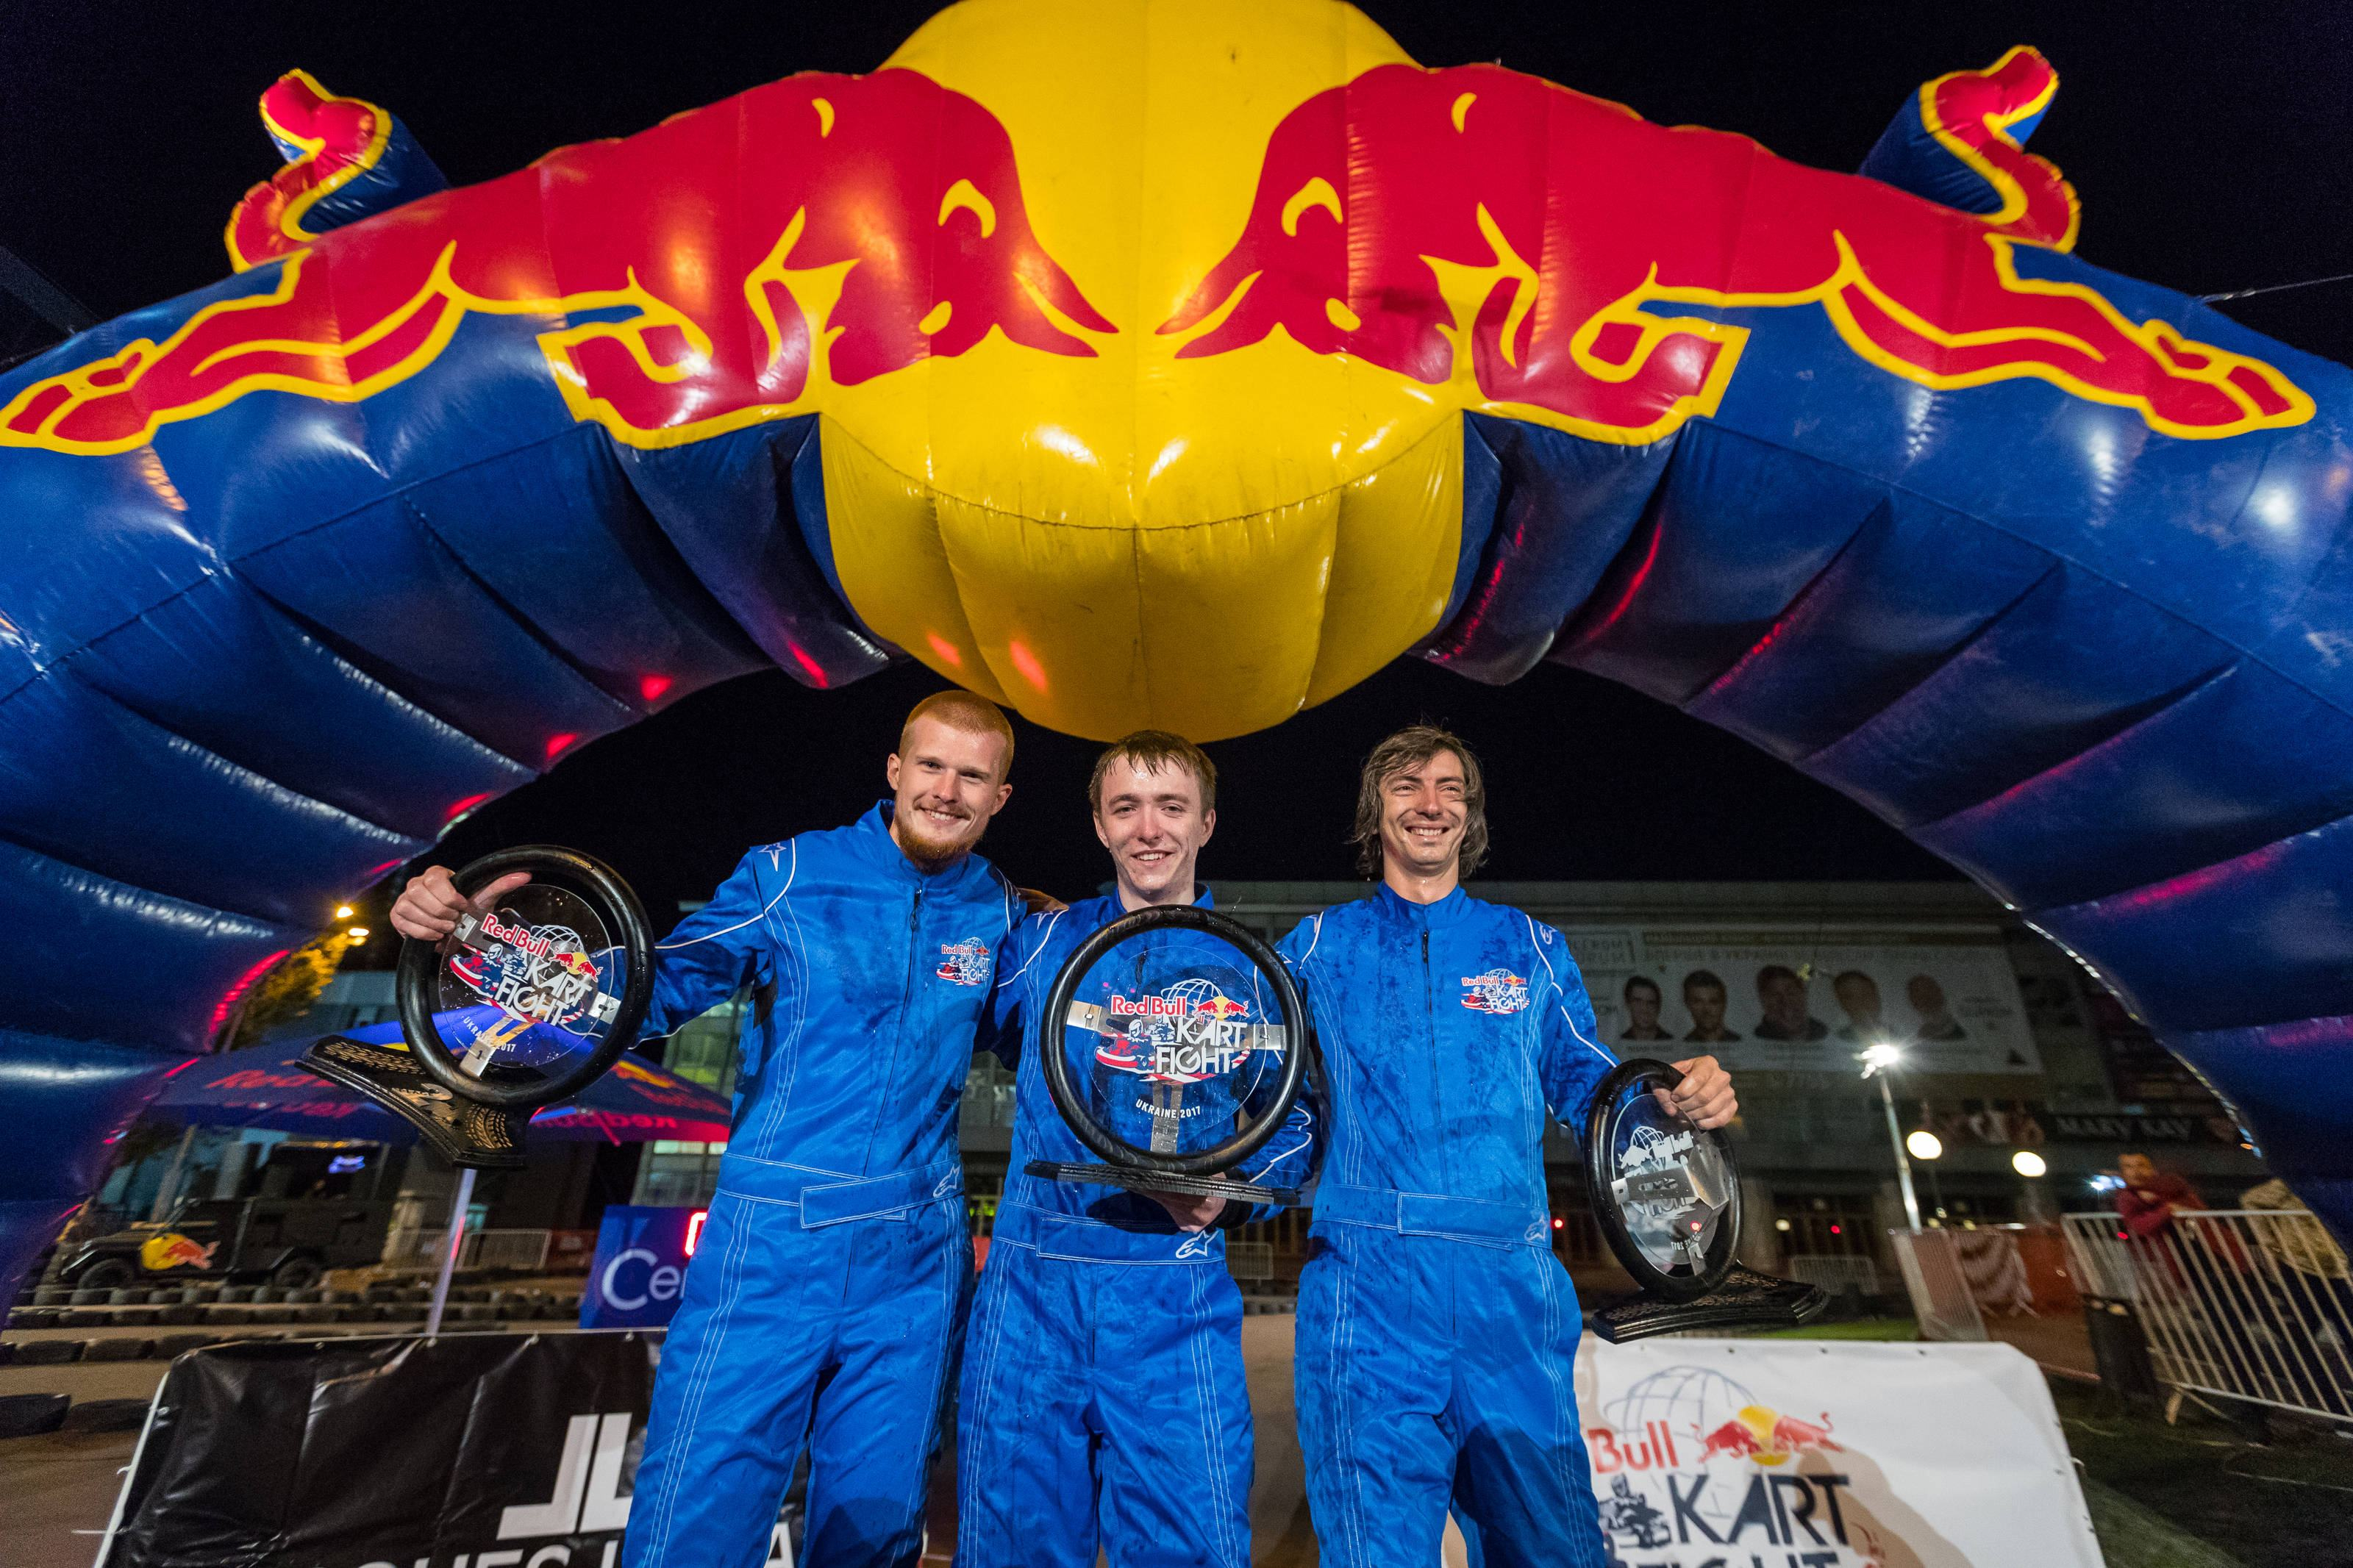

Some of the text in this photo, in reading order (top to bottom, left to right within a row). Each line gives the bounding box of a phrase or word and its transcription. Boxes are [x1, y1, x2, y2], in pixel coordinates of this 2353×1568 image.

[480, 913, 551, 959] Red Bull
[942, 945, 973, 954] Red Bull
[969, 955, 990, 970] KART
[524, 957, 593, 1007] KART
[962, 968, 987, 981] FIGHT
[1462, 975, 1499, 986] Red Bull
[494, 976, 570, 1025] FIGHT
[1496, 985, 1527, 999] KART
[1111, 995, 1187, 1015] Red Bull
[1489, 998, 1524, 1011] FIGHT
[1176, 1017, 1248, 1048] KART
[496, 1042, 516, 1052] 017
[1154, 1047, 1235, 1074] FIGHT
[1135, 1099, 1201, 1118] UKRAINE 2017
[1588, 1420, 1679, 1474] Bull
[1667, 1474, 1851, 1546] KART
